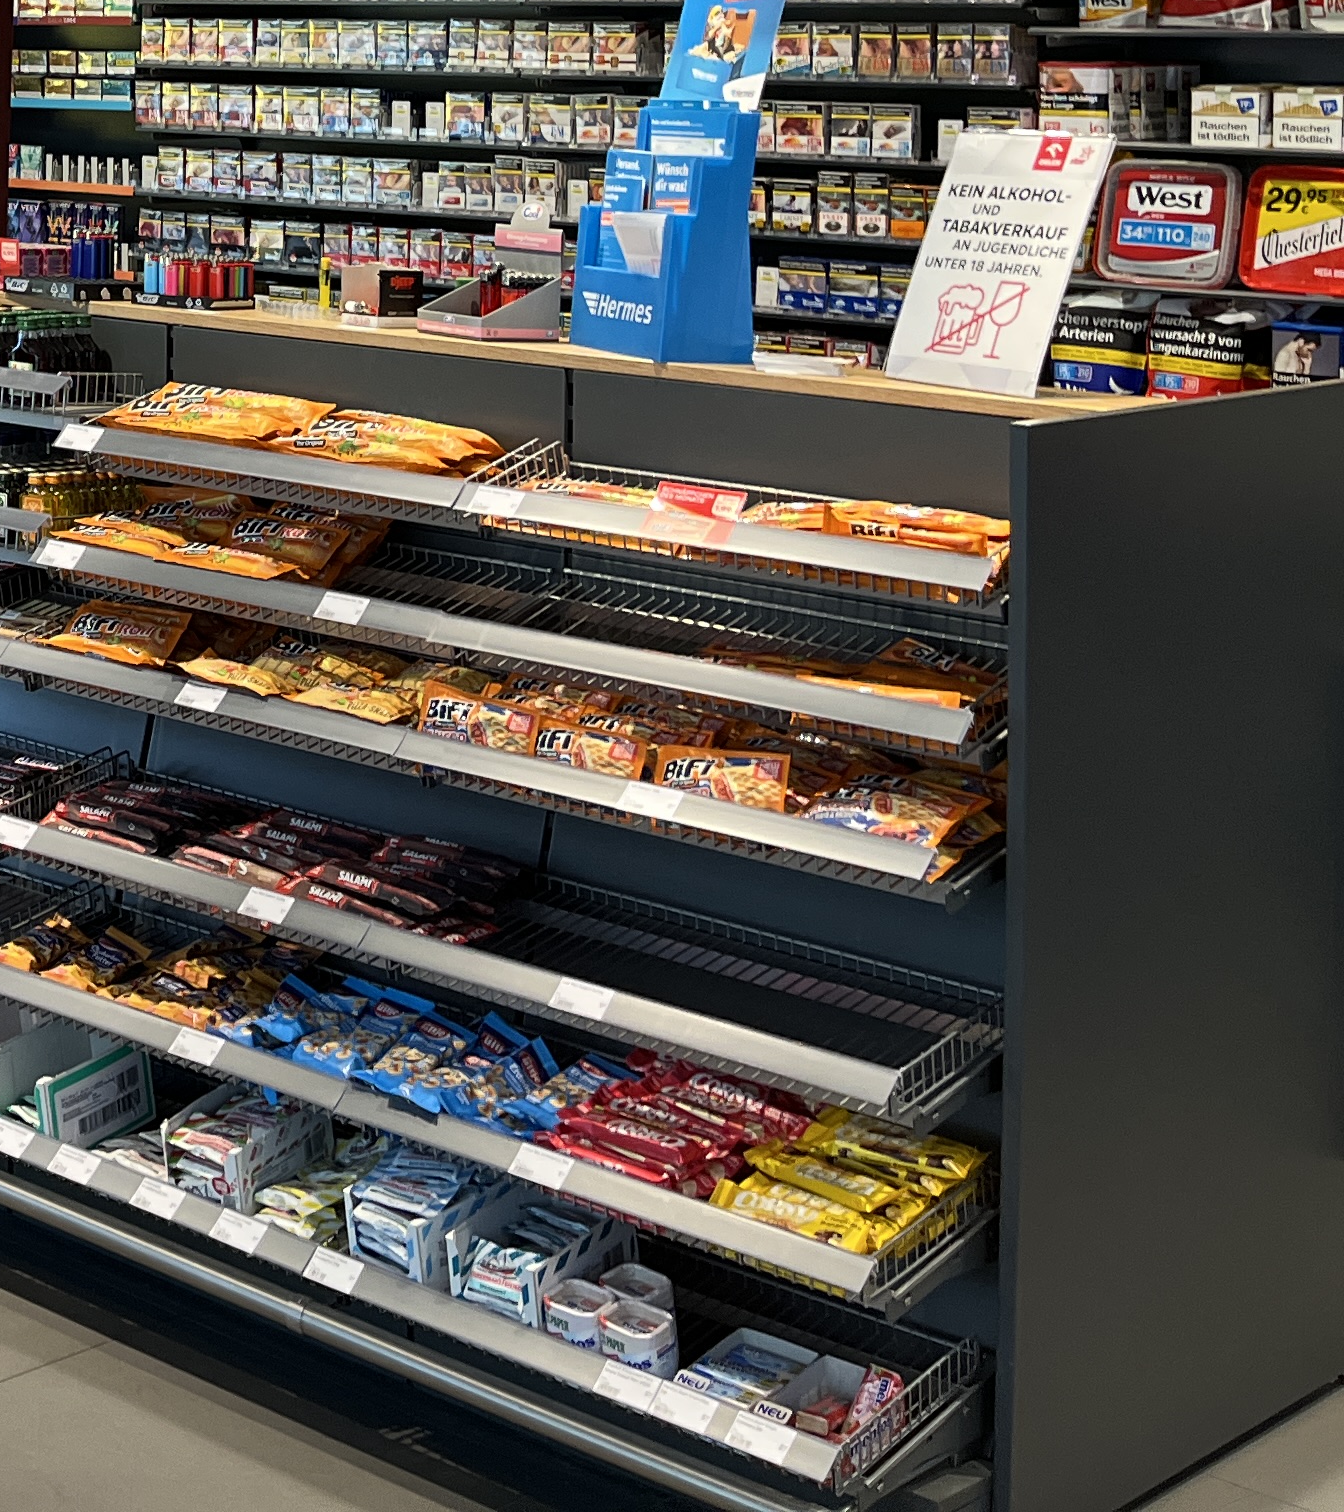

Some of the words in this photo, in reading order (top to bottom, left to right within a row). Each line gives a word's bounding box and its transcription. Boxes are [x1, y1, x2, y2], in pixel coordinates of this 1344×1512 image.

[1200, 122, 1248, 131] Rauchen
[1282, 123, 1331, 133] Rauchen
[1197, 132, 1209, 140] ist
[1210, 131, 1250, 142] tödlich
[1279, 133, 1291, 142] ist
[1294, 133, 1333, 144] tödlich
[656, 161, 689, 176] Wünsch
[948, 184, 985, 199] KEIN
[988, 187, 1072, 204] ALKOHOL-
[1135, 185, 1204, 210] West
[972, 203, 1001, 216] UND
[942, 219, 1069, 241] TABAKVERKAUF
[1261, 210, 1344, 265] Chesterfiel
[952, 240, 971, 251] AN
[973, 241, 1069, 260] JUGENDLICHE
[924, 257, 967, 270] UNTER
[971, 259, 984, 272] 18
[986, 261, 1043, 278] JAHREN.
[597, 293, 653, 324] Hermes
[1092, 315, 1148, 333] verstopf
[1154, 314, 1200, 328] Rauchen
[1060, 328, 1114, 343] Arterien
[1208, 332, 1216, 345] 9
[1218, 335, 1242, 348] von
[427, 696, 472, 717] BiFi
[662, 758, 715, 780] BiFi
[80, 805, 110, 819] SALAMI
[338, 870, 374, 888] SALAMI
[308, 884, 345, 903] SALAMI
[677, 1372, 707, 1390] NEU
[756, 1402, 788, 1421] NEU
